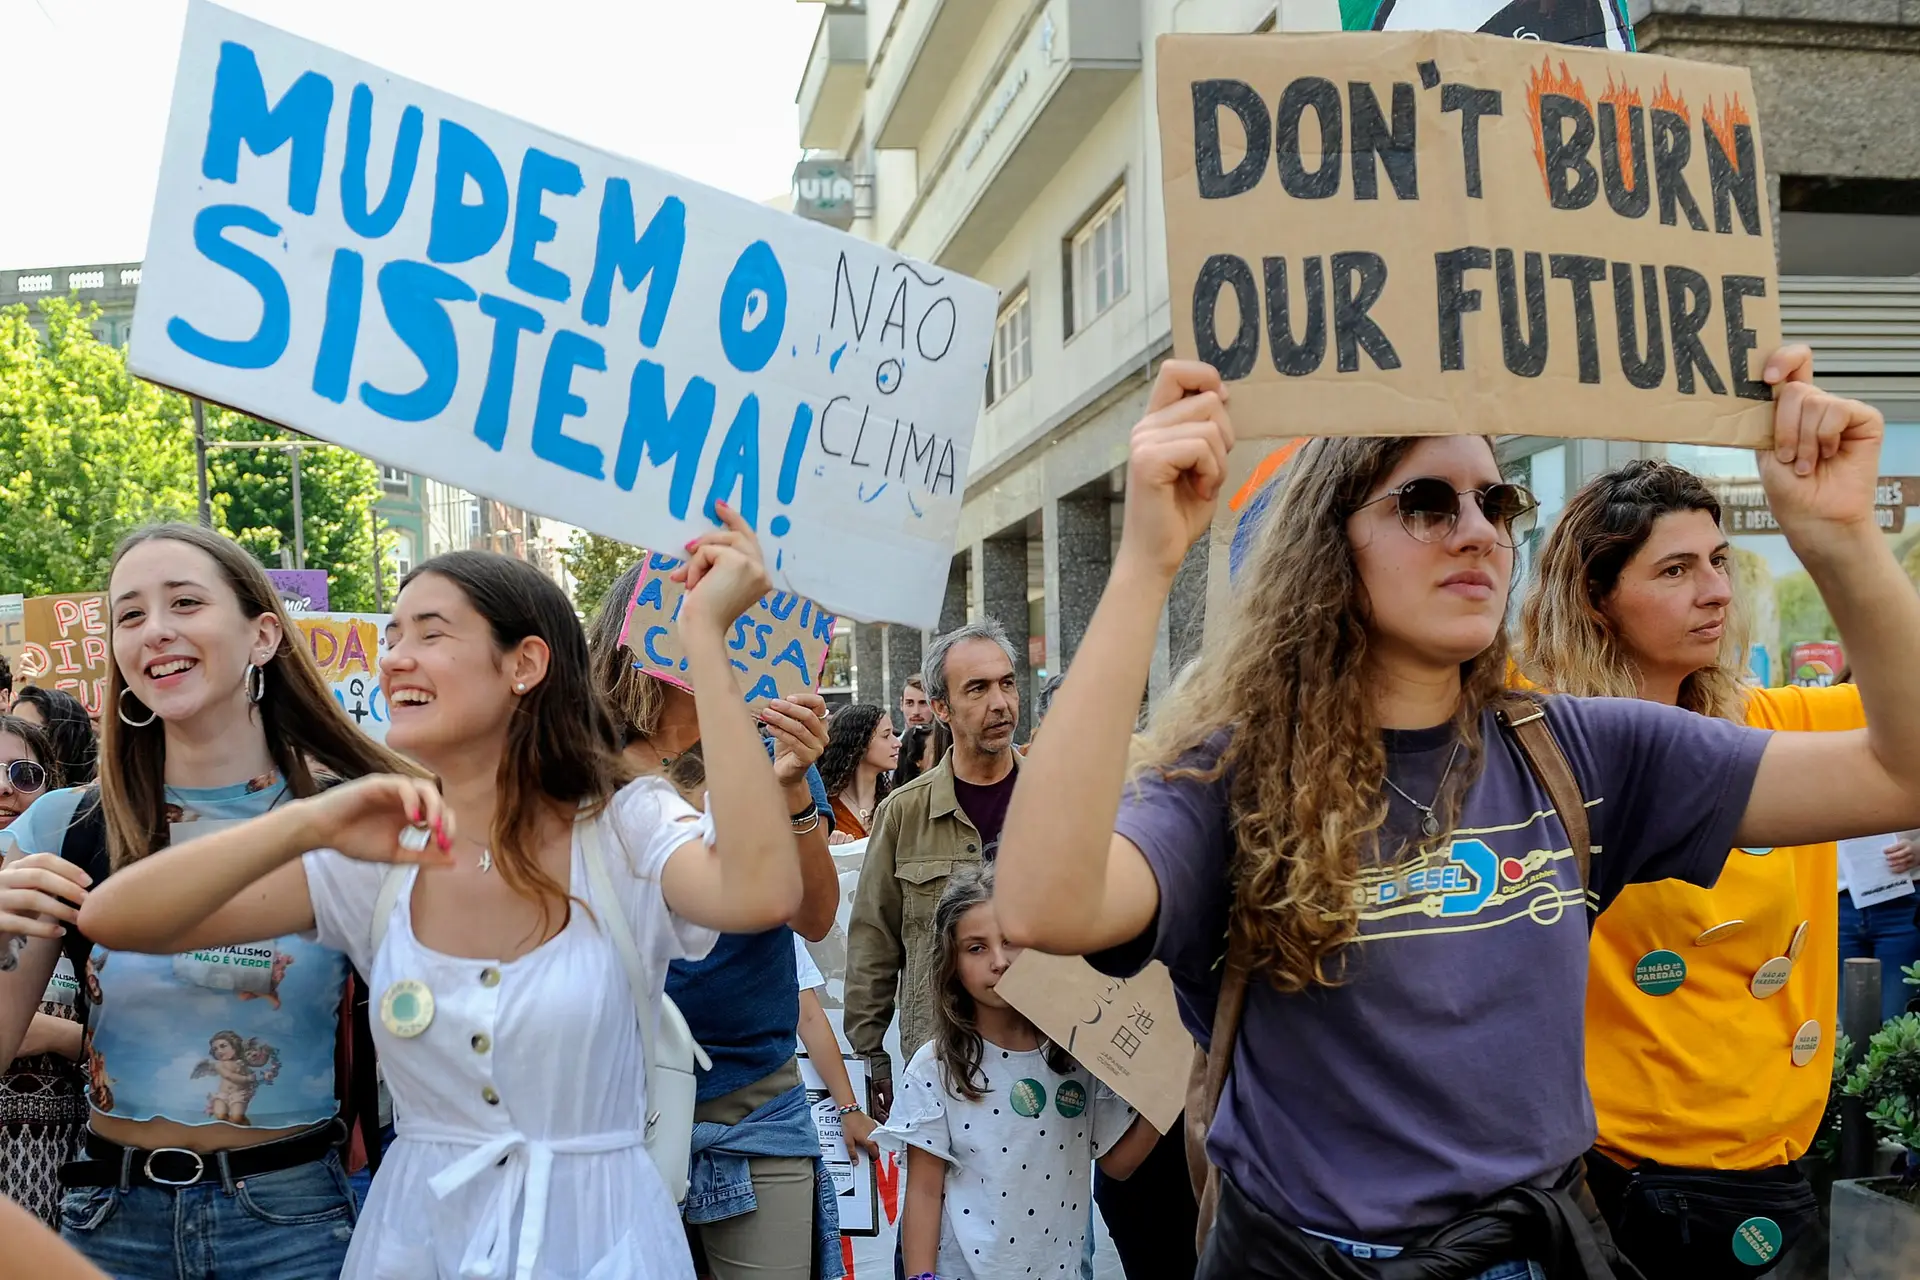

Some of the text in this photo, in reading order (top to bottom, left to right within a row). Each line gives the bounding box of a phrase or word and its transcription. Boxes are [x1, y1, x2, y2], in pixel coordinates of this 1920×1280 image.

[1191, 58, 1503, 201] DON'T
[1539, 92, 1763, 236] BURN
[202, 40, 787, 373] MUDEM O
[829, 250, 956, 362] NÃO
[1191, 245, 1774, 401] OUR FUTURE
[166, 203, 813, 537] SISTEMA!
[819, 395, 955, 496] CLIMA
[24, 638, 108, 679] DIR
[194, 951, 220, 963] NÃO
[233, 956, 271, 968] VERDE
[1636, 970, 1683, 982] PAREDÃO
[819, 1116, 842, 1124] FEPA
[1749, 1225, 1773, 1252] NÃO AO
